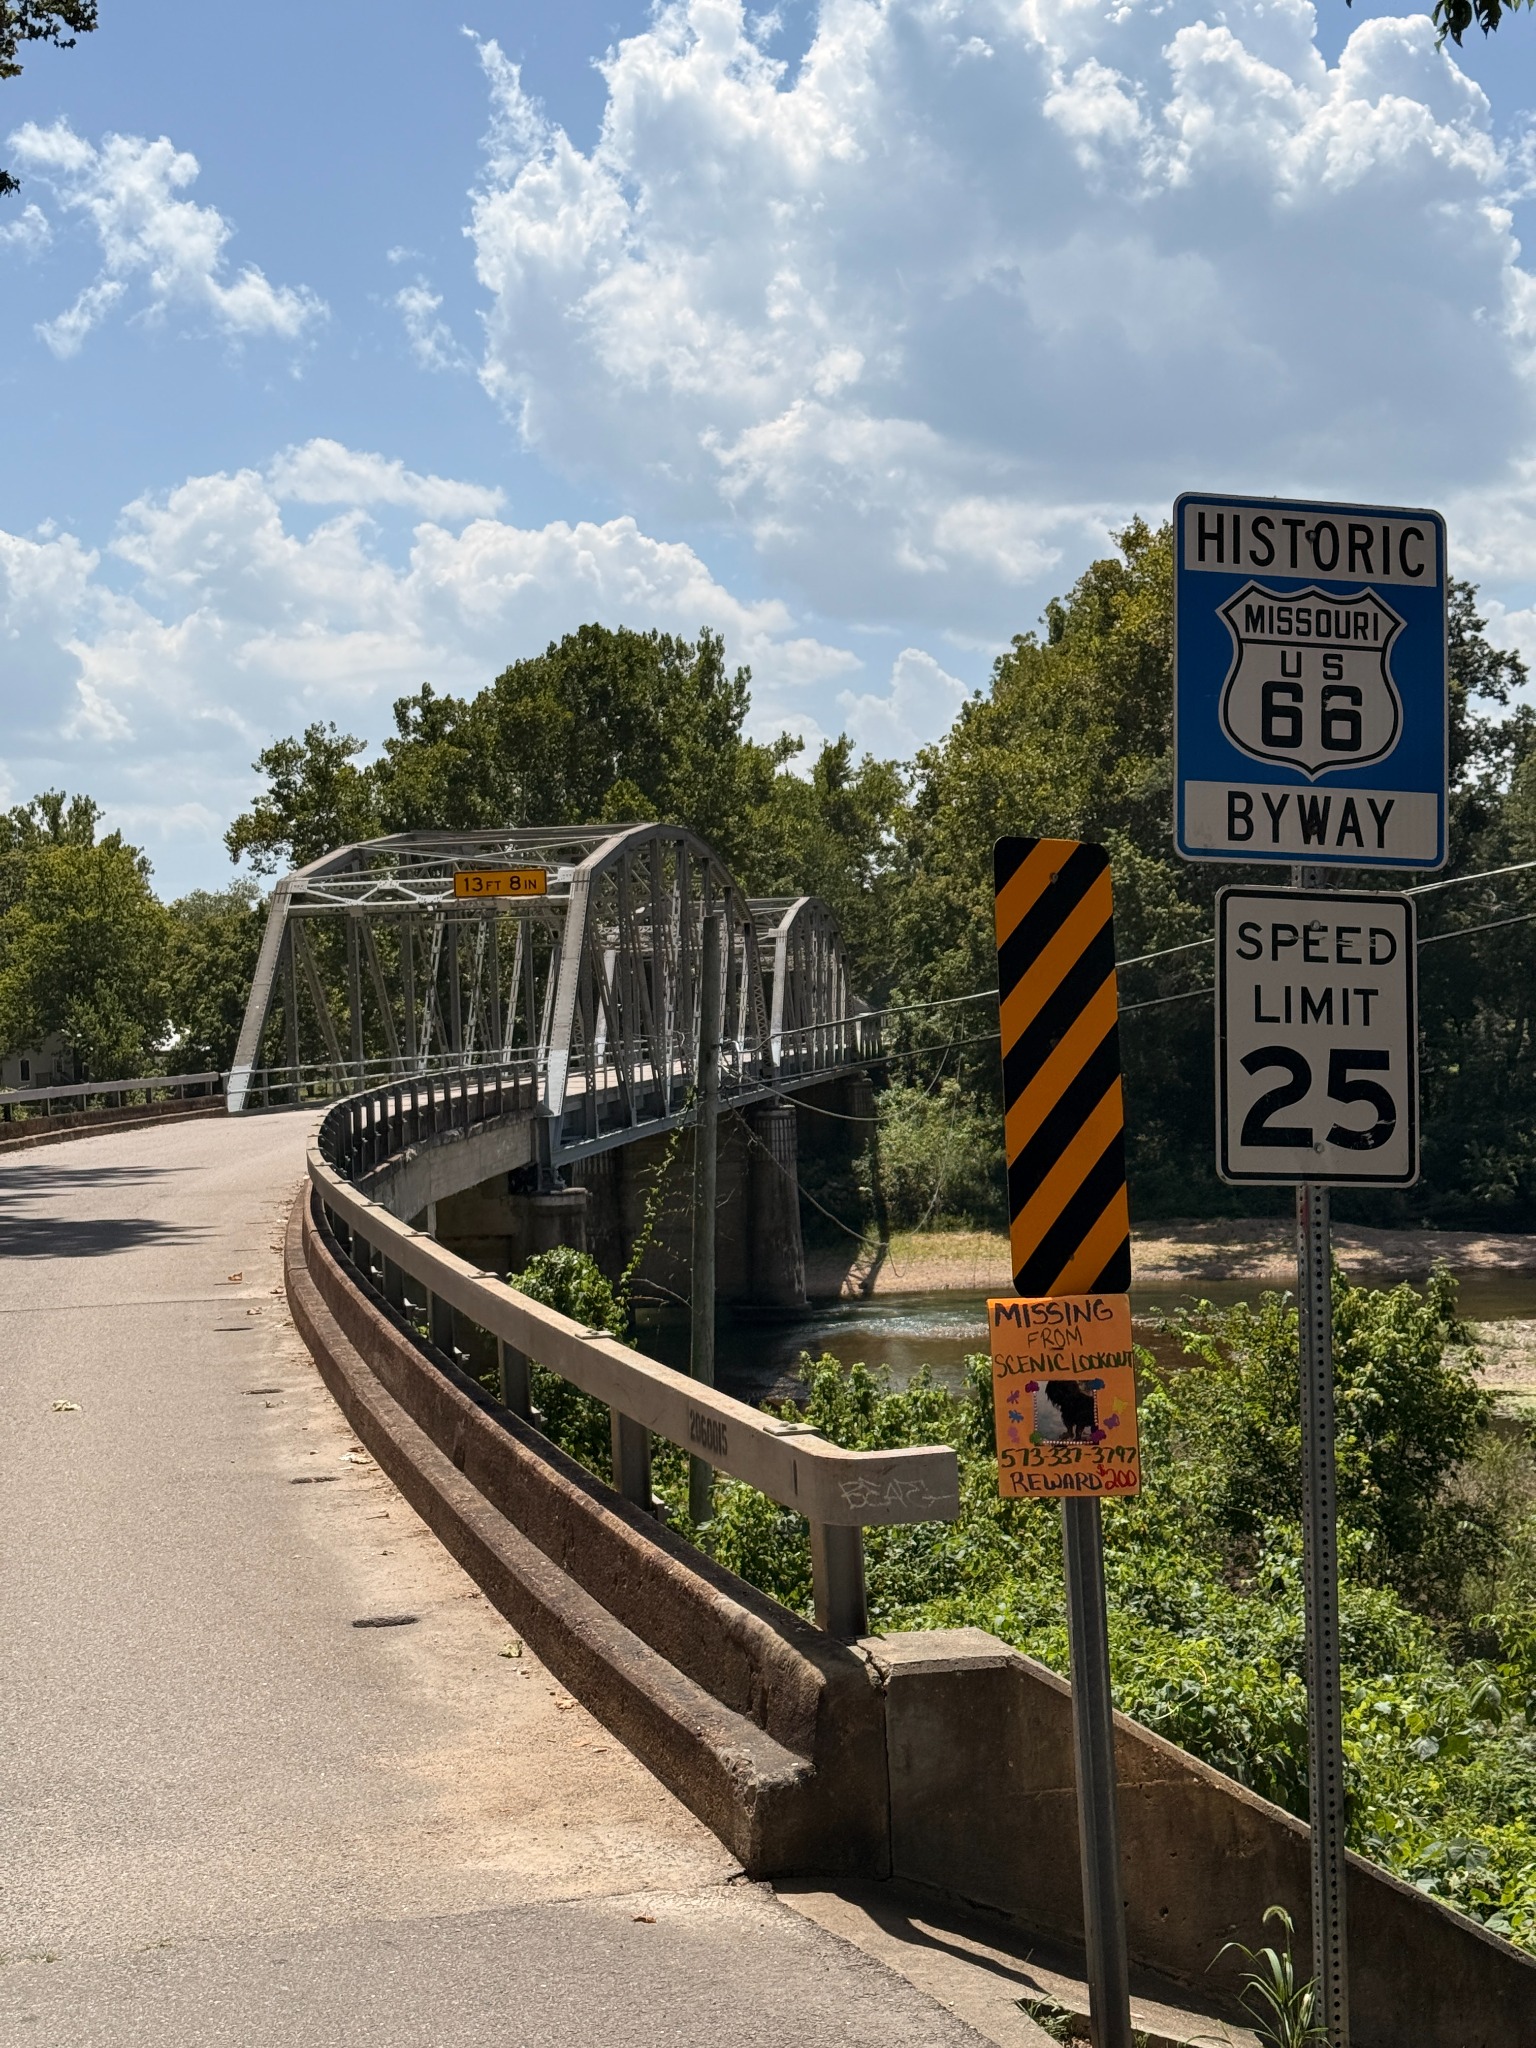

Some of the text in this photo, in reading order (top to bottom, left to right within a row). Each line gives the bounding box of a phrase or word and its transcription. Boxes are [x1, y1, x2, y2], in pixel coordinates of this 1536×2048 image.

[1197, 511, 1426, 578] HISTORIC
[1244, 603, 1379, 641] MISSOURI
[1261, 680, 1363, 752] 66
[1227, 790, 1396, 849] BYWAY
[1235, 921, 1397, 966] SPEED
[1254, 984, 1380, 1027] LIMIT
[1239, 1045, 1397, 1151] 25
[994, 1299, 1114, 1329] MISSING
[1027, 1325, 1084, 1350] FROM
[994, 1350, 1135, 1379] SCENIC LOOKOUT
[1000, 1447, 1137, 1468] 573-337-3797
[1010, 1464, 1138, 1494] REWARD $200
